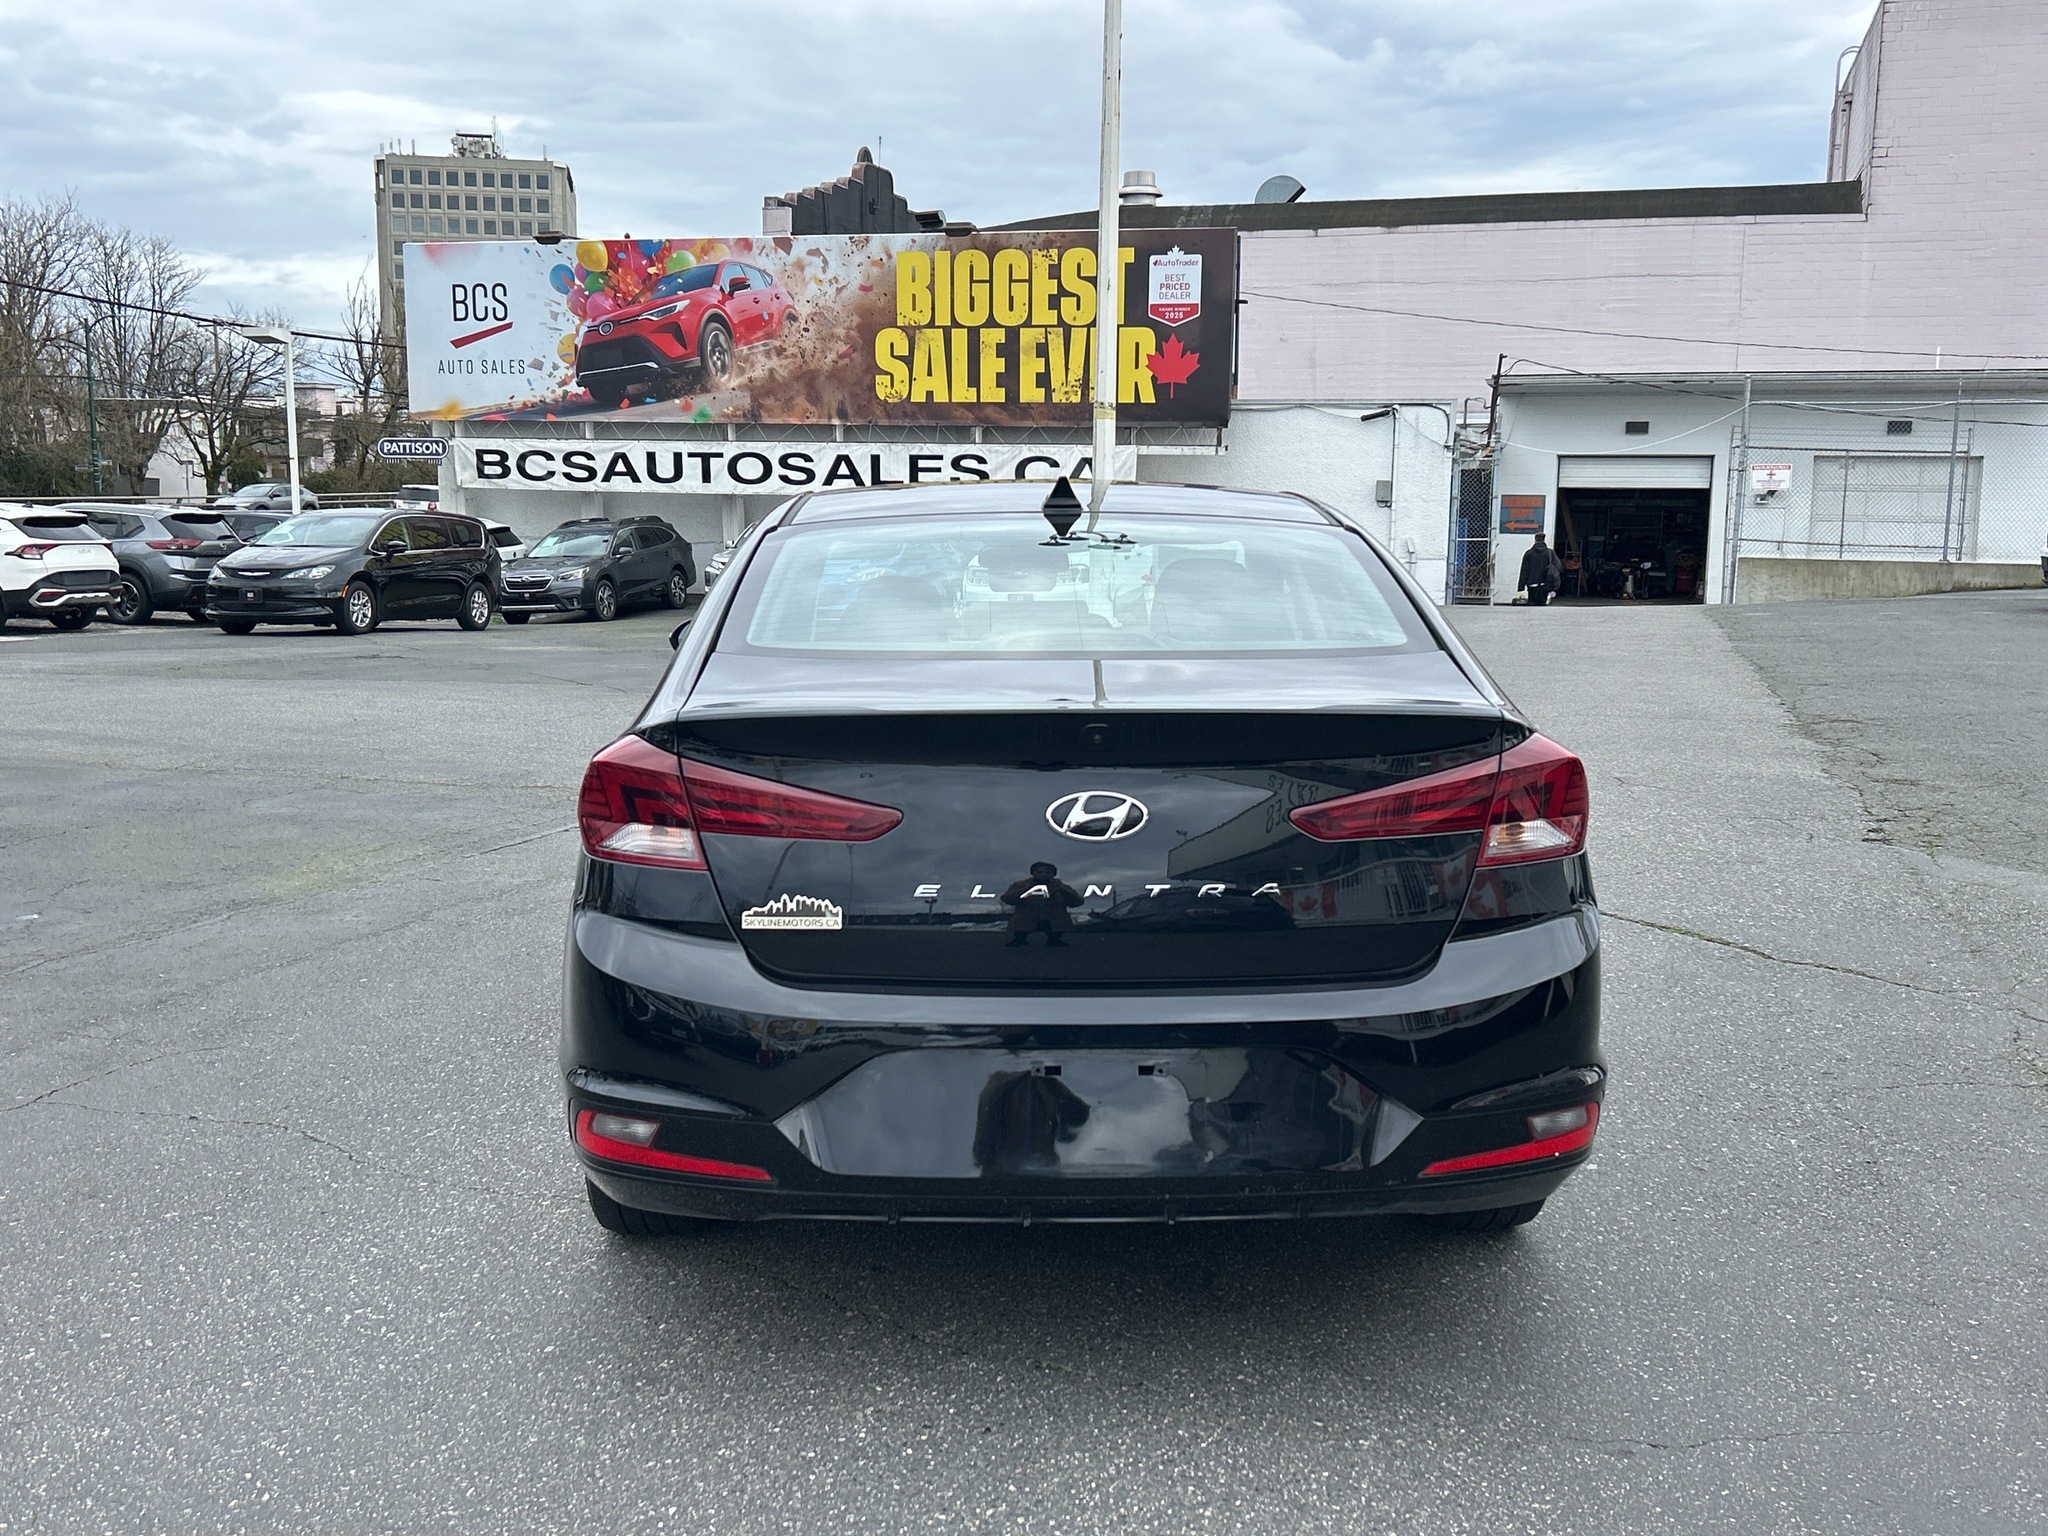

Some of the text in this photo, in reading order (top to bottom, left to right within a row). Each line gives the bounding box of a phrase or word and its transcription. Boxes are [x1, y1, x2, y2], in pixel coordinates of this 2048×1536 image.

[1164, 273, 1186, 282] BEST
[1159, 282, 1190, 291] PRICED
[1159, 291, 1191, 300] DEALER
[451, 282, 509, 322] BCS
[438, 358, 526, 375] AUTO SALES
[875, 327, 1156, 404] SALE EVR
[383, 442, 443, 454] PATTISON
[913, 882, 1282, 899] ELANTRA
[743, 918, 840, 927] SKYLINEMOTORS.CA
